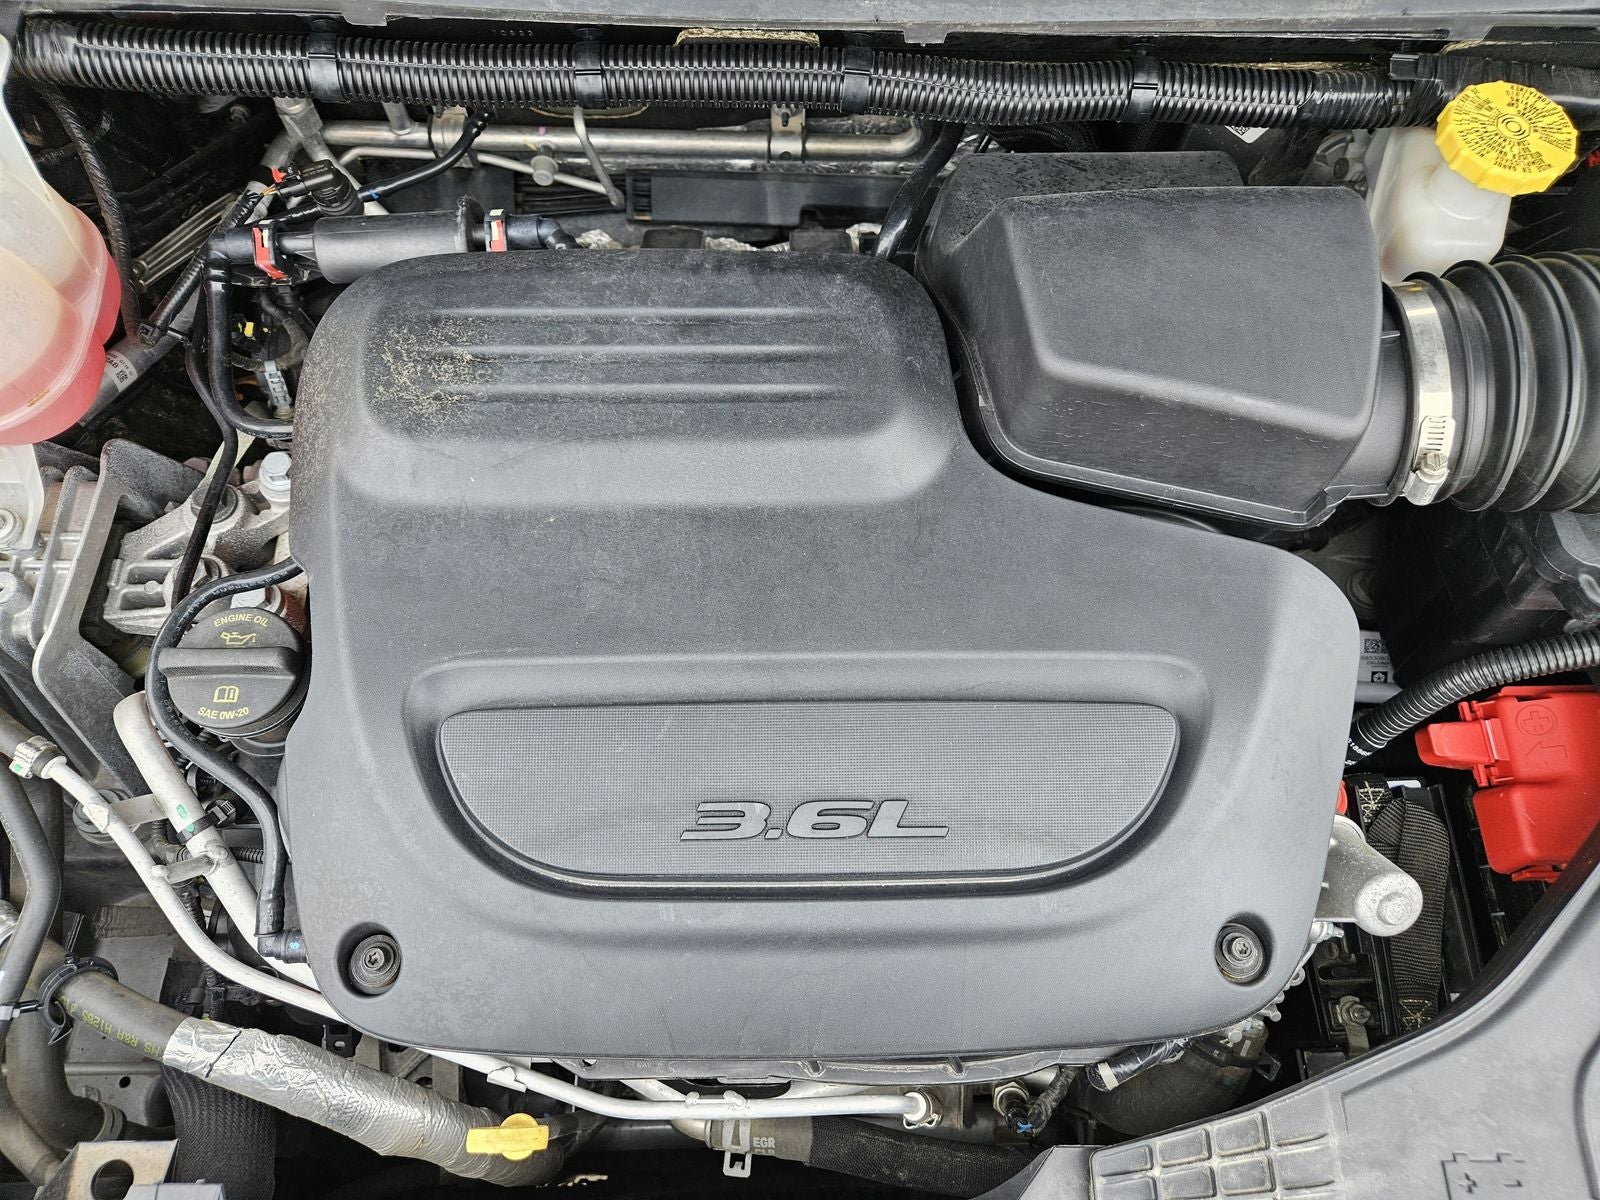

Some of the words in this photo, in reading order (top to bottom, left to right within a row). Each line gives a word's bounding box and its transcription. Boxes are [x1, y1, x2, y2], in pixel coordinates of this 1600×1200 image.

[214, 613, 253, 628] ENGINE
[253, 615, 269, 627] OIL
[198, 706, 218, 719] SAE
[219, 706, 249, 719] 0W-20
[680, 799, 950, 841] 3.6L
[752, 1136, 776, 1149] EGR
